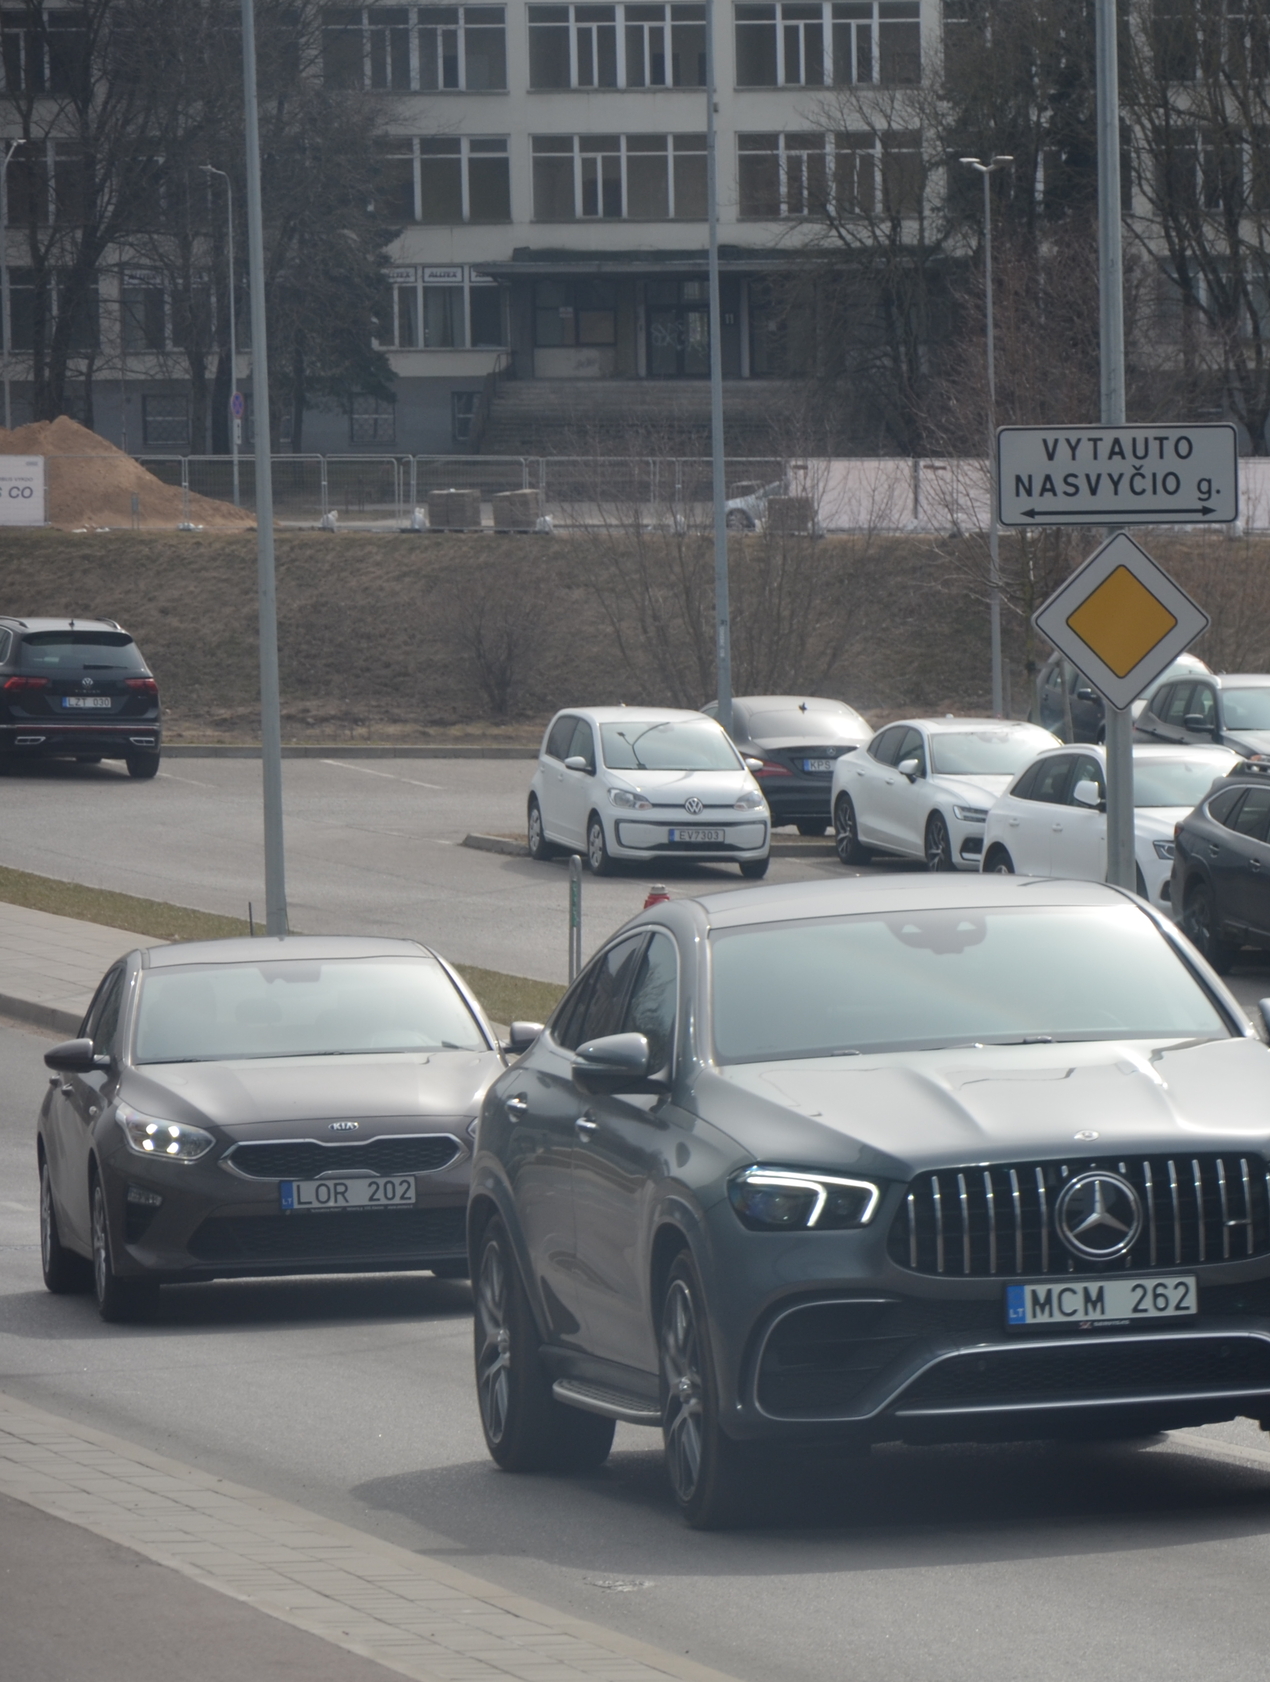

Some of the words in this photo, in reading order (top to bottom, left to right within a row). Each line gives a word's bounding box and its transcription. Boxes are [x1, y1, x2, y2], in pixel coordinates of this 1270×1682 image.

[1042, 435, 1194, 462] VYTAUTO
[1014, 464, 1182, 498] NASVYČIO
[1196, 477, 1222, 502] g.
[8, 486, 34, 499] CO
[68, 697, 87, 706] LZT
[92, 698, 110, 706] 030
[810, 760, 832, 770] KPS
[679, 831, 719, 841] EV7303
[296, 1182, 350, 1206] LOR
[367, 1179, 413, 1203] 202
[1031, 1285, 1105, 1319] MCM
[1131, 1281, 1191, 1314] 262
[1010, 1308, 1025, 1318] LT
